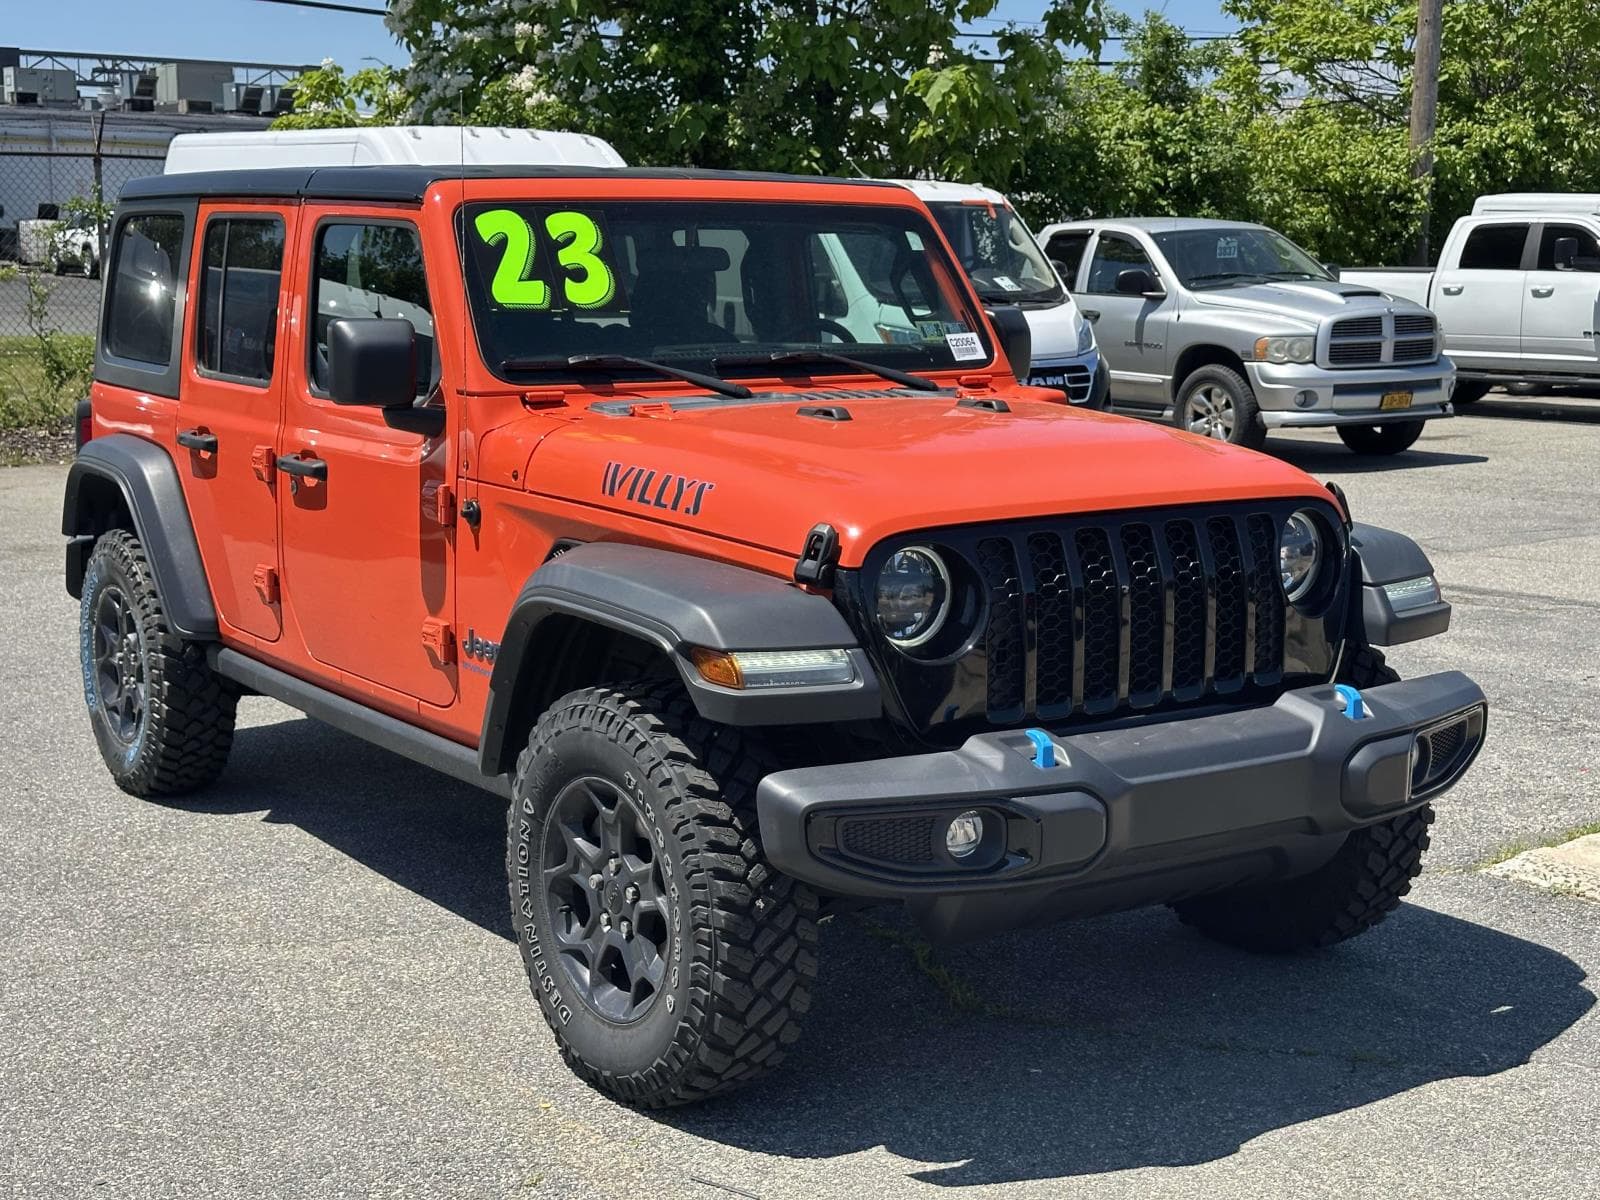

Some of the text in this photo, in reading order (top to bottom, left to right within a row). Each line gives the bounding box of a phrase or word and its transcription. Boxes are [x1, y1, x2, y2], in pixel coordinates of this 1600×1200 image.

[474, 209, 616, 309] 23
[601, 461, 714, 516] WILLYS
[517, 819, 572, 1026] DESTINATION
